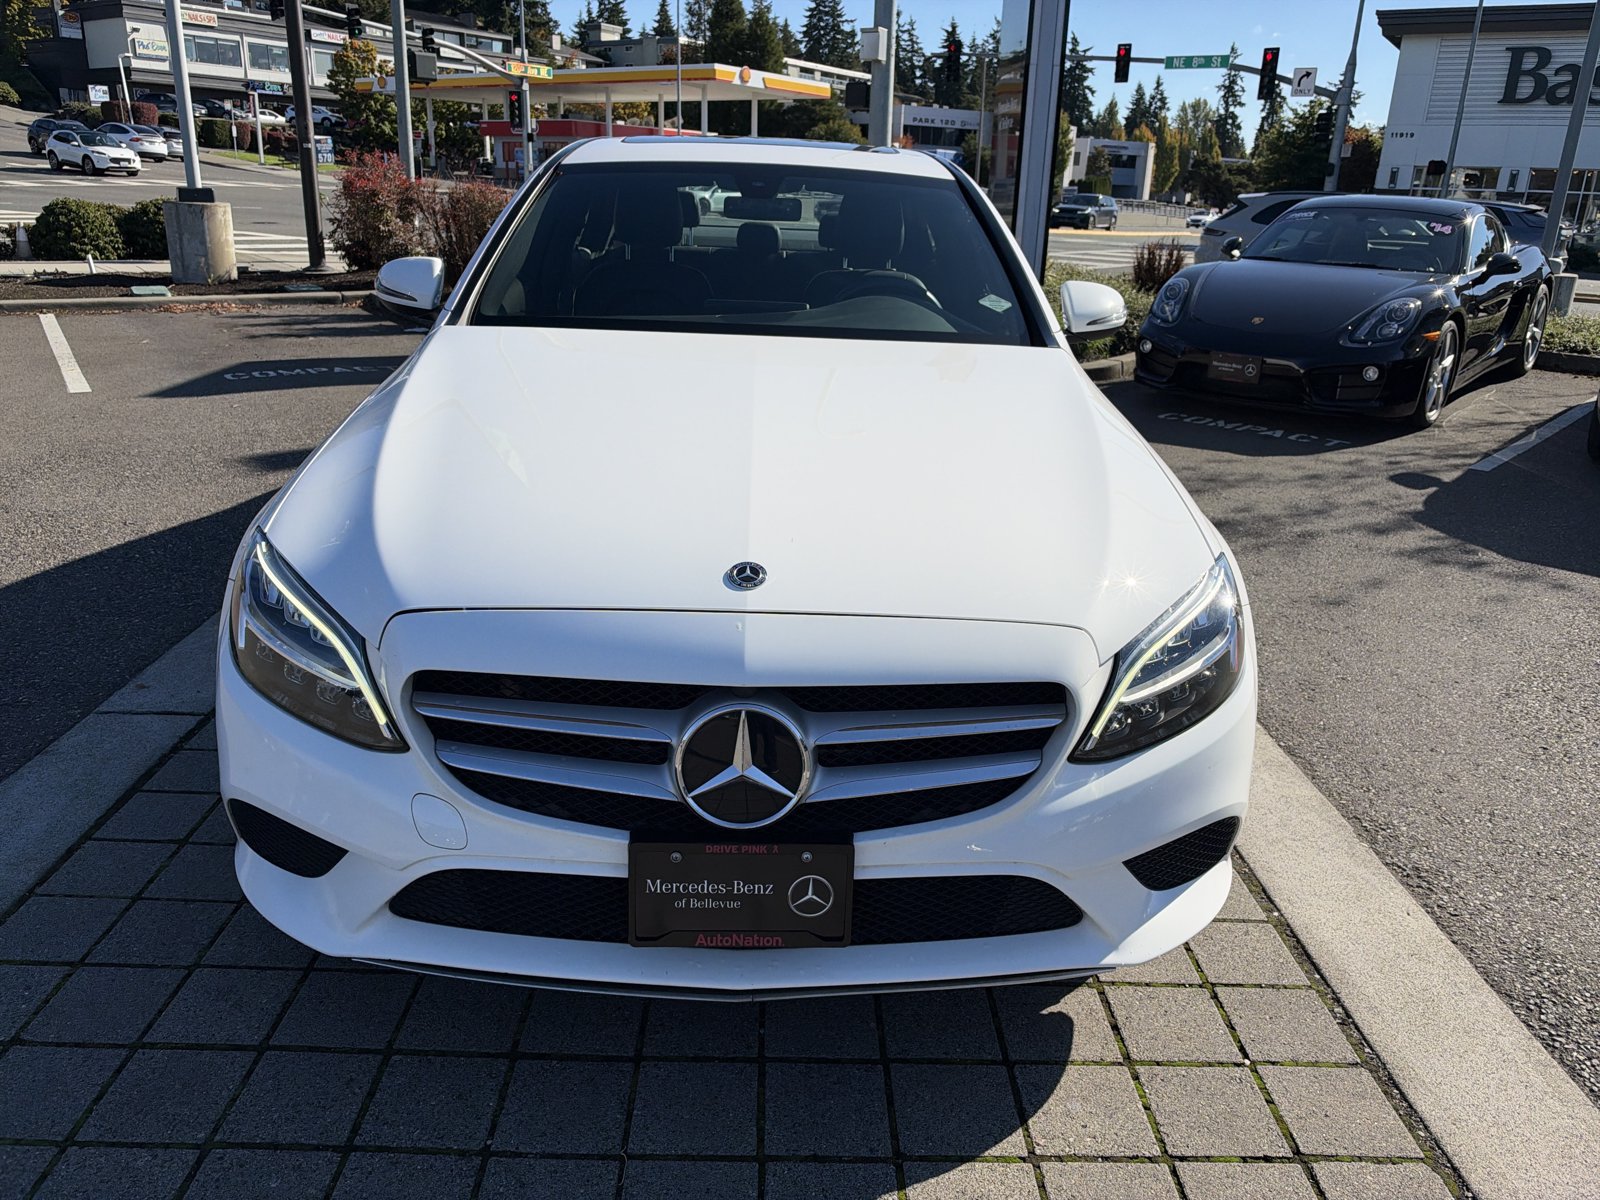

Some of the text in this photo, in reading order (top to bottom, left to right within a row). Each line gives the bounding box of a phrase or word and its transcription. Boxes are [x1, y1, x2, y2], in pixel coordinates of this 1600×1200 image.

[1172, 56, 1222, 68] NE 8th St
[912, 117, 936, 125] PARK
[940, 119, 957, 127] 120
[223, 365, 398, 381] COMPACT
[1157, 412, 1351, 447] COMPACT
[705, 845, 768, 854] DRIVE PINK
[645, 879, 774, 895] Mercedes-Benz
[674, 898, 741, 909] of Bellevue
[695, 933, 783, 947] AutoNation
